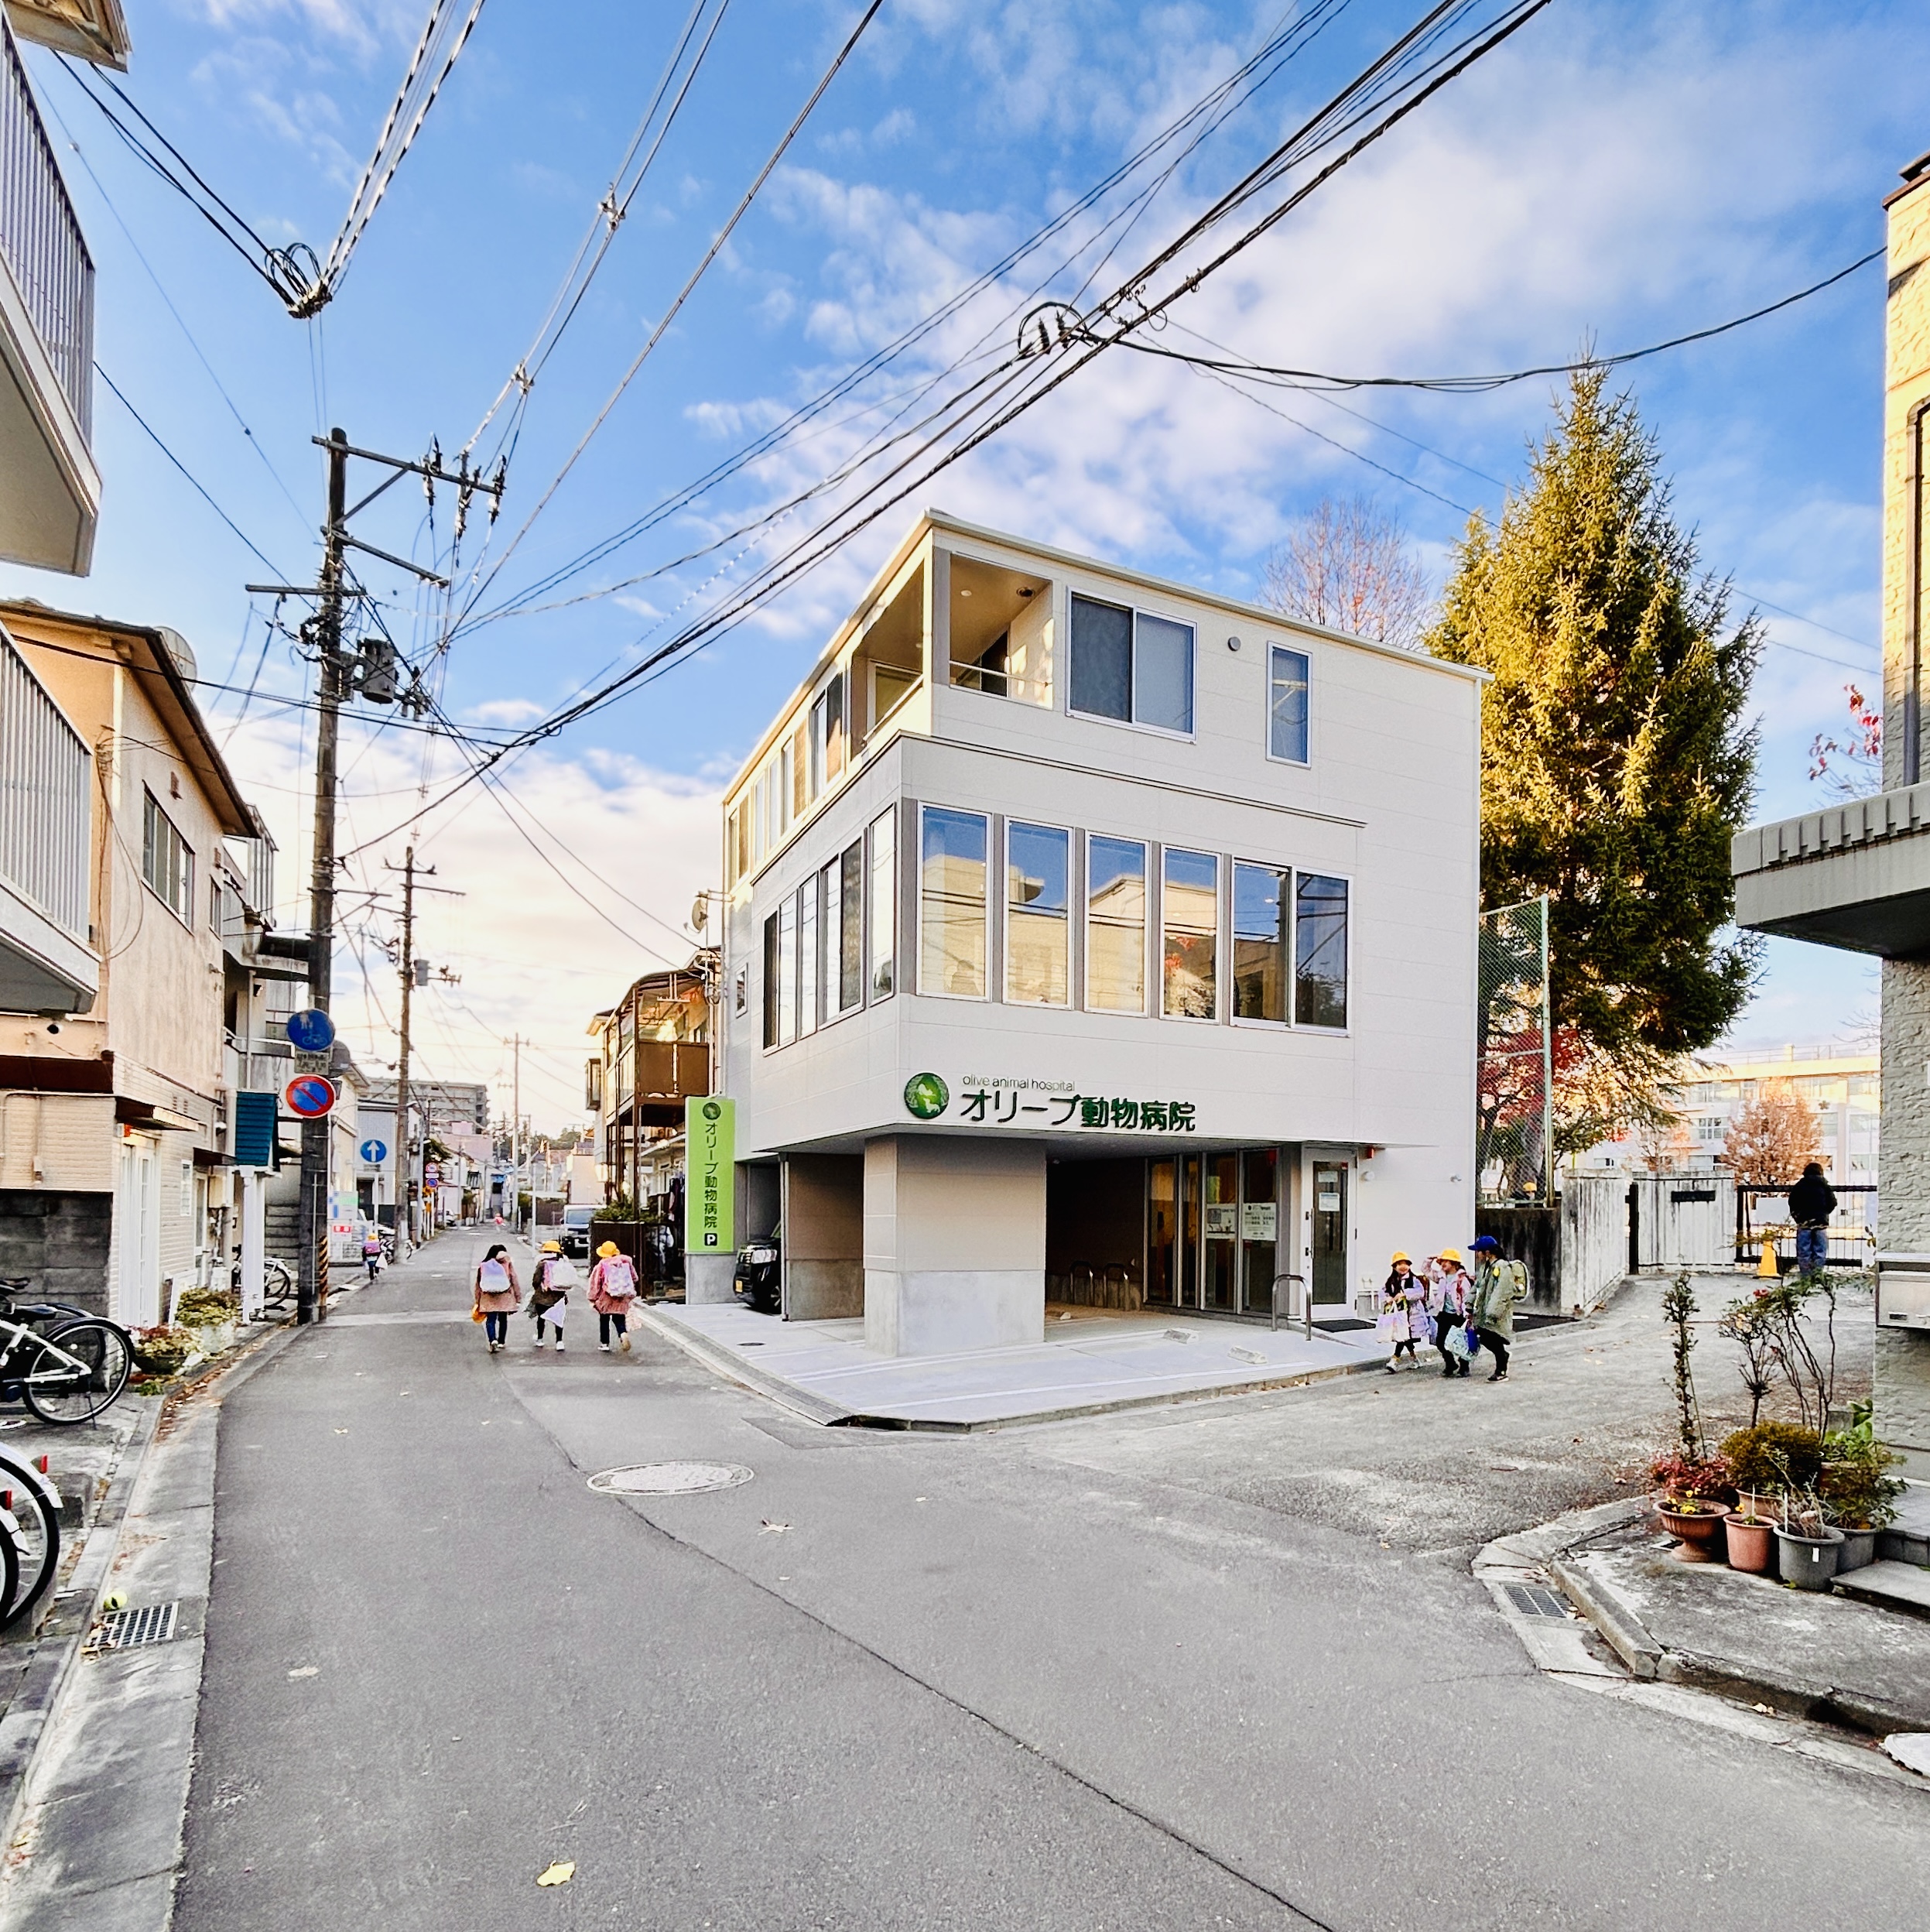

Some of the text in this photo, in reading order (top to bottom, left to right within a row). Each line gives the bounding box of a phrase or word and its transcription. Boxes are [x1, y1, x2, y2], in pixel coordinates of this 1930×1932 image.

[963, 1074, 1075, 1091] olive animal hospital
[960, 1088, 1196, 1132] オリーブ動物病院
[704, 1122, 718, 1228] オリーブ動物病院
[707, 1234, 716, 1245] P
